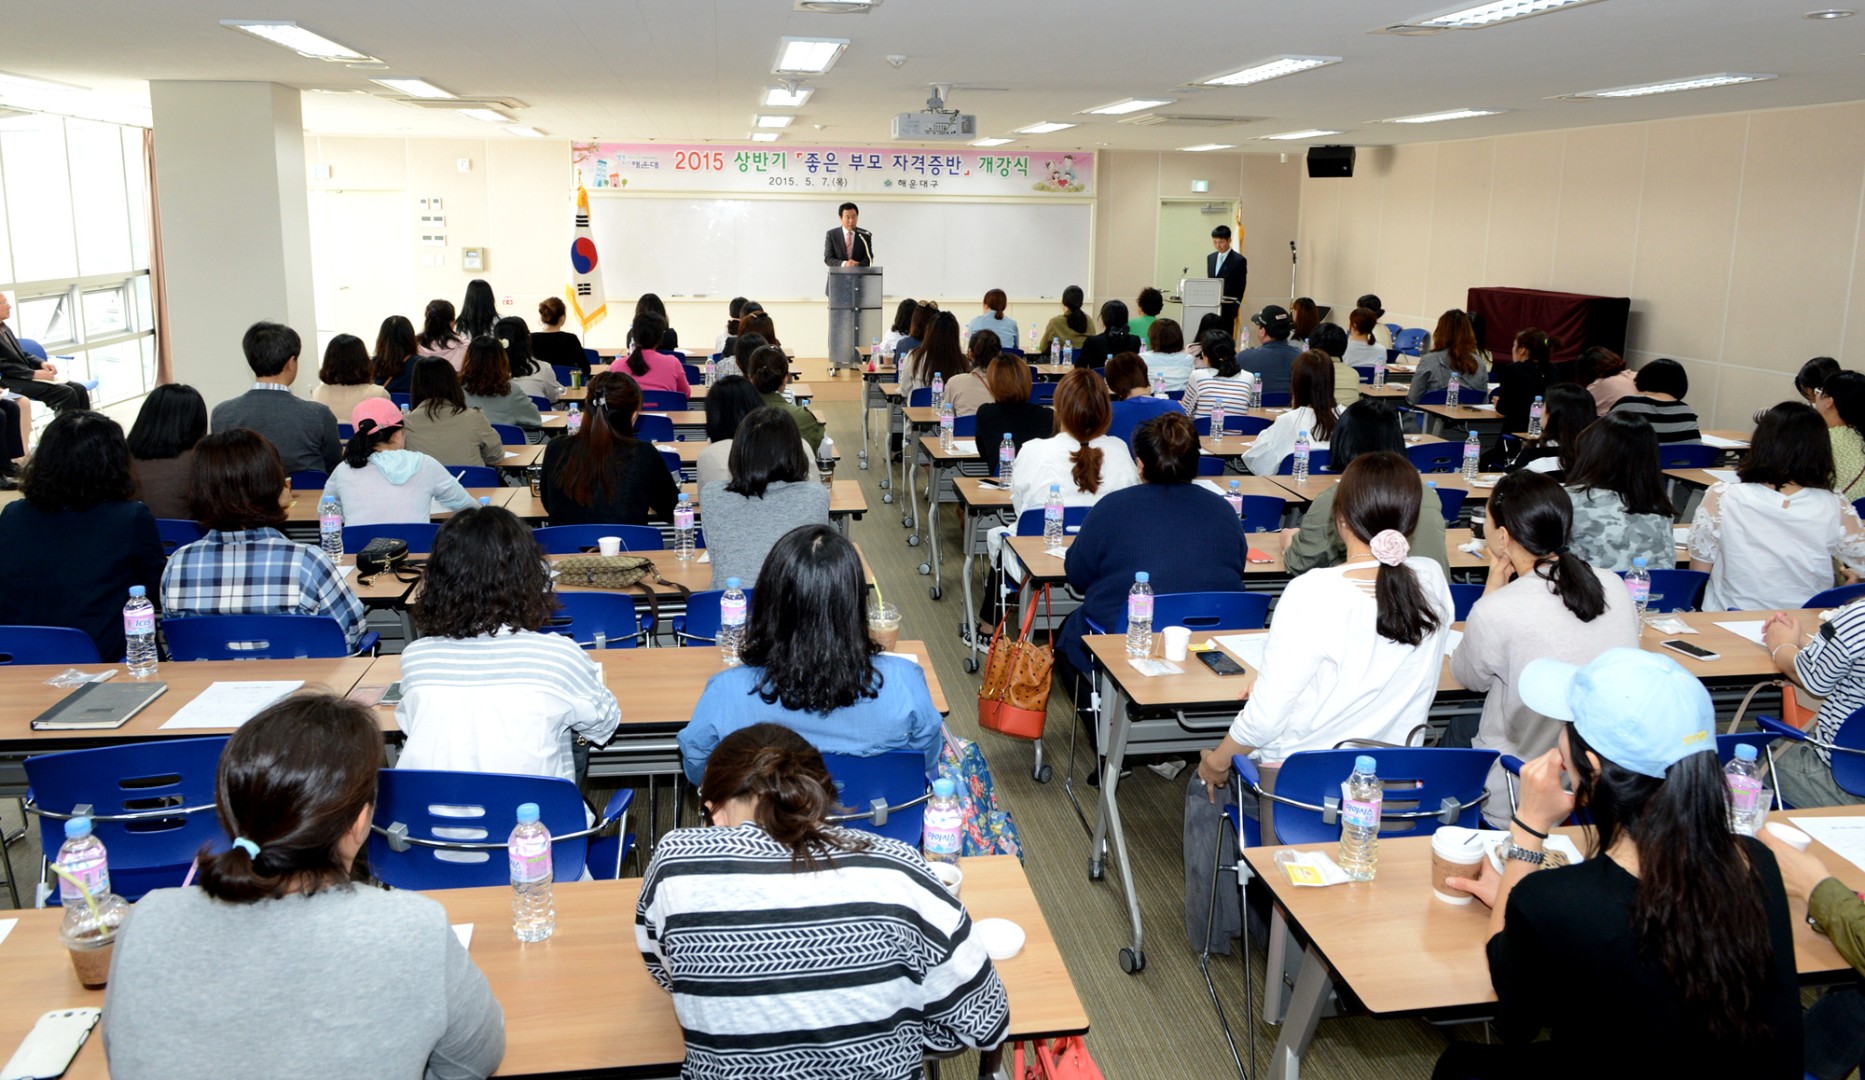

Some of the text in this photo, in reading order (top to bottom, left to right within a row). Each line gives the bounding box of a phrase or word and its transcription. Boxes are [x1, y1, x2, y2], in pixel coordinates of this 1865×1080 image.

[675, 151, 724, 171] 2015
[734, 152, 786, 173] 상반기
[849, 154, 882, 171] 부모
[979, 156, 1029, 177] 개강식
[769, 177, 798, 186] 2015.
[805, 177, 814, 186] 5.
[898, 179, 939, 189] 해운대구
[135, 619, 152, 628] ICIS
